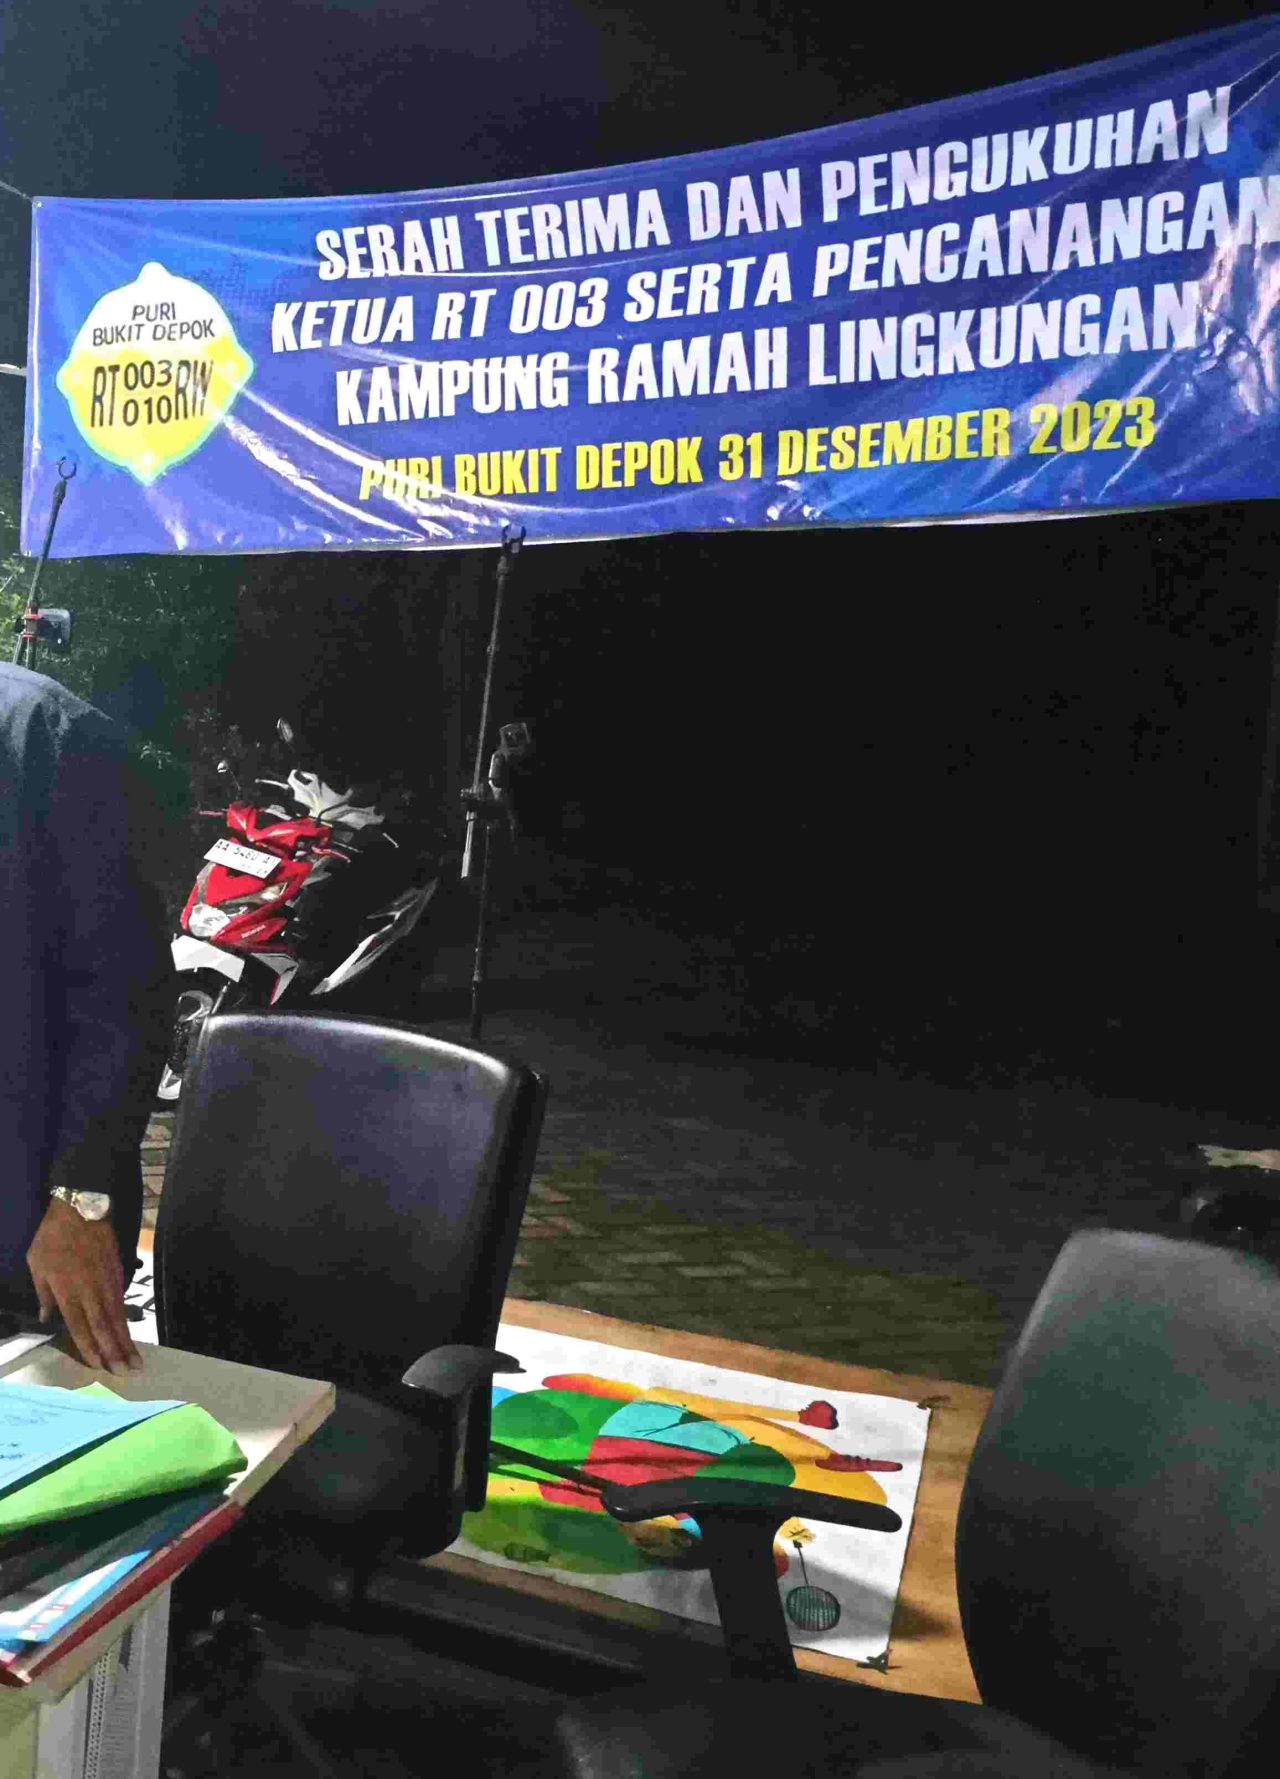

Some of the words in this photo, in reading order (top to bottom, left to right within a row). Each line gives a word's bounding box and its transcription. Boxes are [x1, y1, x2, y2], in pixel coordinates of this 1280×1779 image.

[316, 215, 464, 281] SERAH
[476, 188, 671, 268] TERIMA
[687, 167, 802, 242] DAN
[821, 85, 1232, 223] PENGUKUHAN
[271, 295, 414, 354] KETUA
[433, 288, 496, 340] RT
[508, 277, 608, 334] 003
[623, 257, 792, 323] SERTA
[812, 174, 1280, 299] PENCANANGAN
[92, 322, 146, 347] BUKIT
[151, 318, 216, 341] DEPOK
[131, 301, 177, 322] PURI
[335, 346, 569, 427] KAMPUNG
[587, 326, 789, 405] RAMAH
[808, 281, 1203, 387] LINGKUNGAN
[90, 364, 121, 428] RT
[123, 359, 173, 391] 003
[174, 359, 215, 421] RW
[122, 394, 173, 427] 010
[359, 455, 444, 500] PURI
[454, 446, 563, 498] BUKIT
[575, 436, 703, 490] DEPOK
[719, 430, 763, 481] 31
[777, 407, 1011, 478] DESEMBER
[1030, 396, 1158, 455] 2023
